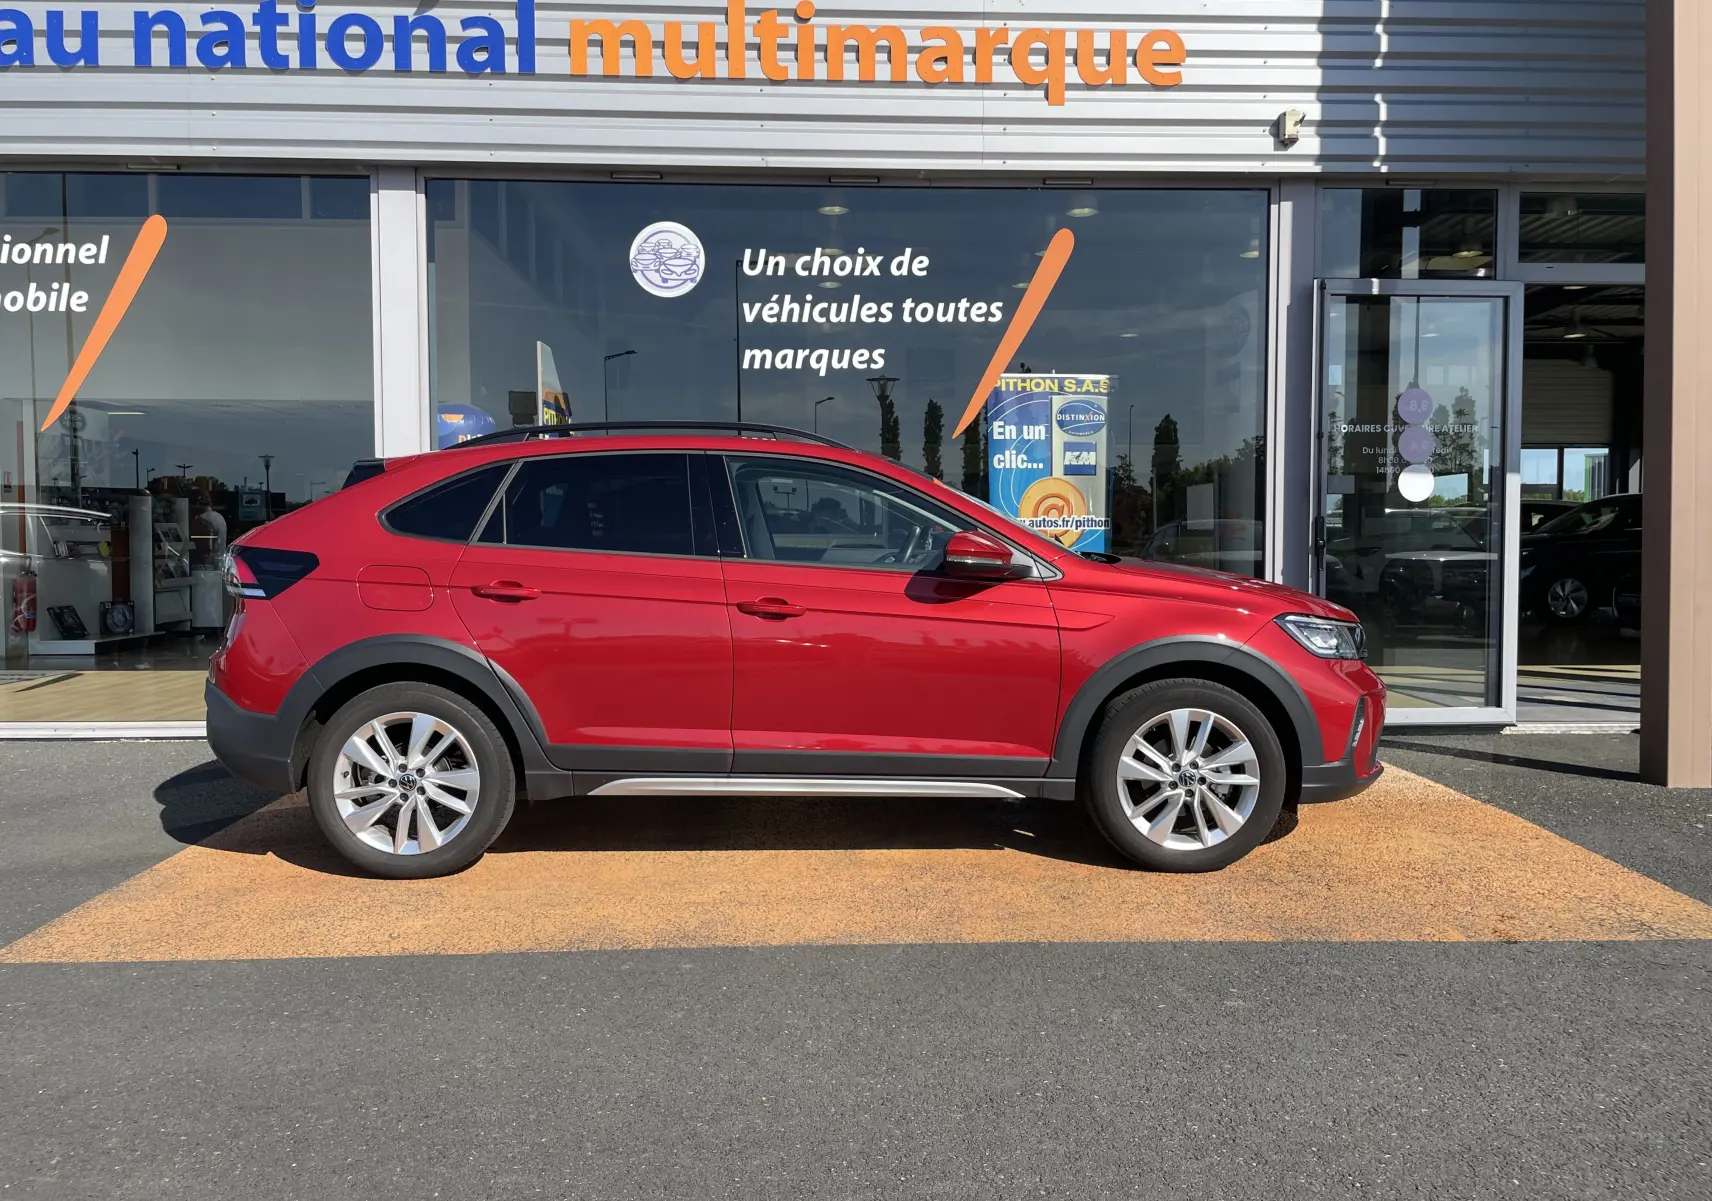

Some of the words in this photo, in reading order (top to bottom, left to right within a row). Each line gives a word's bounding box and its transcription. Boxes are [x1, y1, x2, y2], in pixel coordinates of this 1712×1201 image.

[134, 0, 535, 74] national
[569, 0, 1186, 106] multimarque
[0, 234, 109, 265] ionnel
[742, 249, 786, 276] Un
[795, 247, 883, 276] choix
[890, 247, 929, 276] de
[0, 282, 89, 312] obile
[743, 294, 893, 323] véhicules
[902, 297, 1003, 323] toutes
[742, 348, 885, 377] marques
[994, 378, 1059, 392] ITHON
[1056, 411, 1105, 422] DISTINXION
[1333, 424, 1381, 433] HORAIRES
[1441, 424, 1478, 433] ATELIER
[992, 421, 1017, 440] En
[1023, 424, 1046, 440] un
[993, 450, 1044, 469] clic...
[1362, 446, 1374, 454] Du
